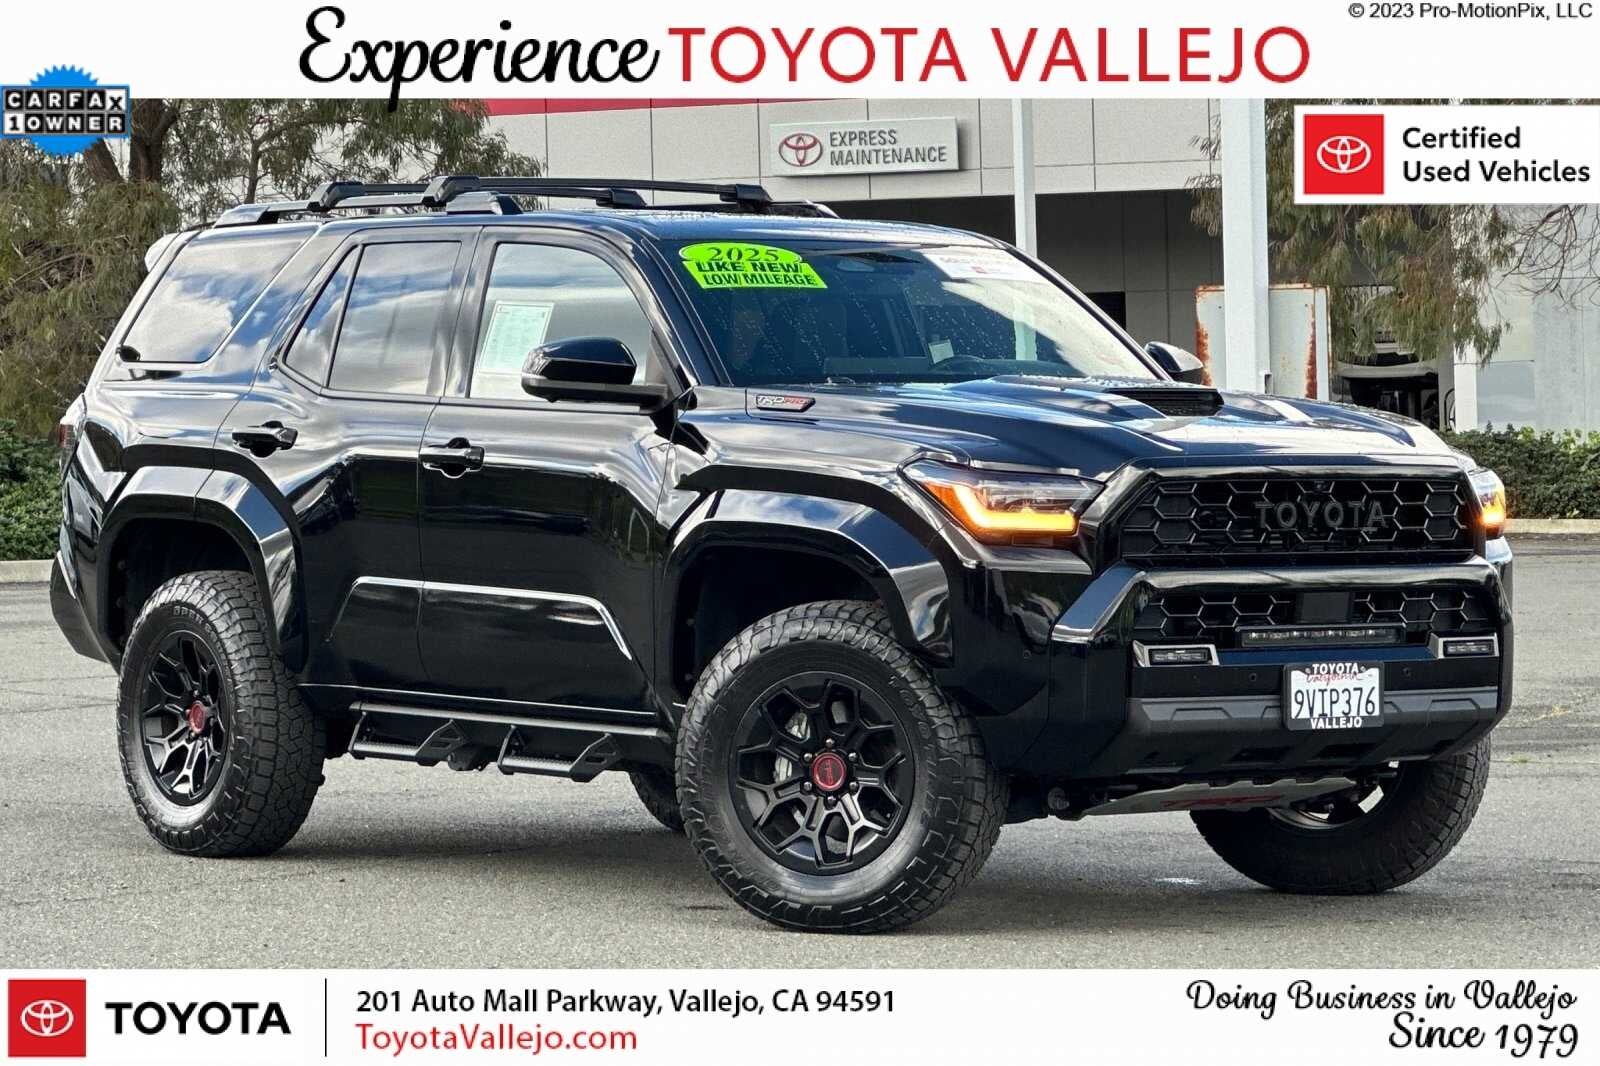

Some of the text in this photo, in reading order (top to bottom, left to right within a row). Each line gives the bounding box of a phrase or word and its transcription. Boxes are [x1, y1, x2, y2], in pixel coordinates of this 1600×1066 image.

[829, 129, 898, 147] EXPRESS
[830, 146, 948, 166] MAINTENANCE
[706, 246, 780, 262] 2025
[696, 262, 799, 273] LIKE NEW
[703, 273, 815, 286] LOW MILEAGE
[1255, 501, 1388, 528] TOYOTA
[1312, 662, 1359, 674] TOYOTA
[1294, 686, 1376, 718] 9VIP376
[1310, 717, 1362, 729] VALLEJO
